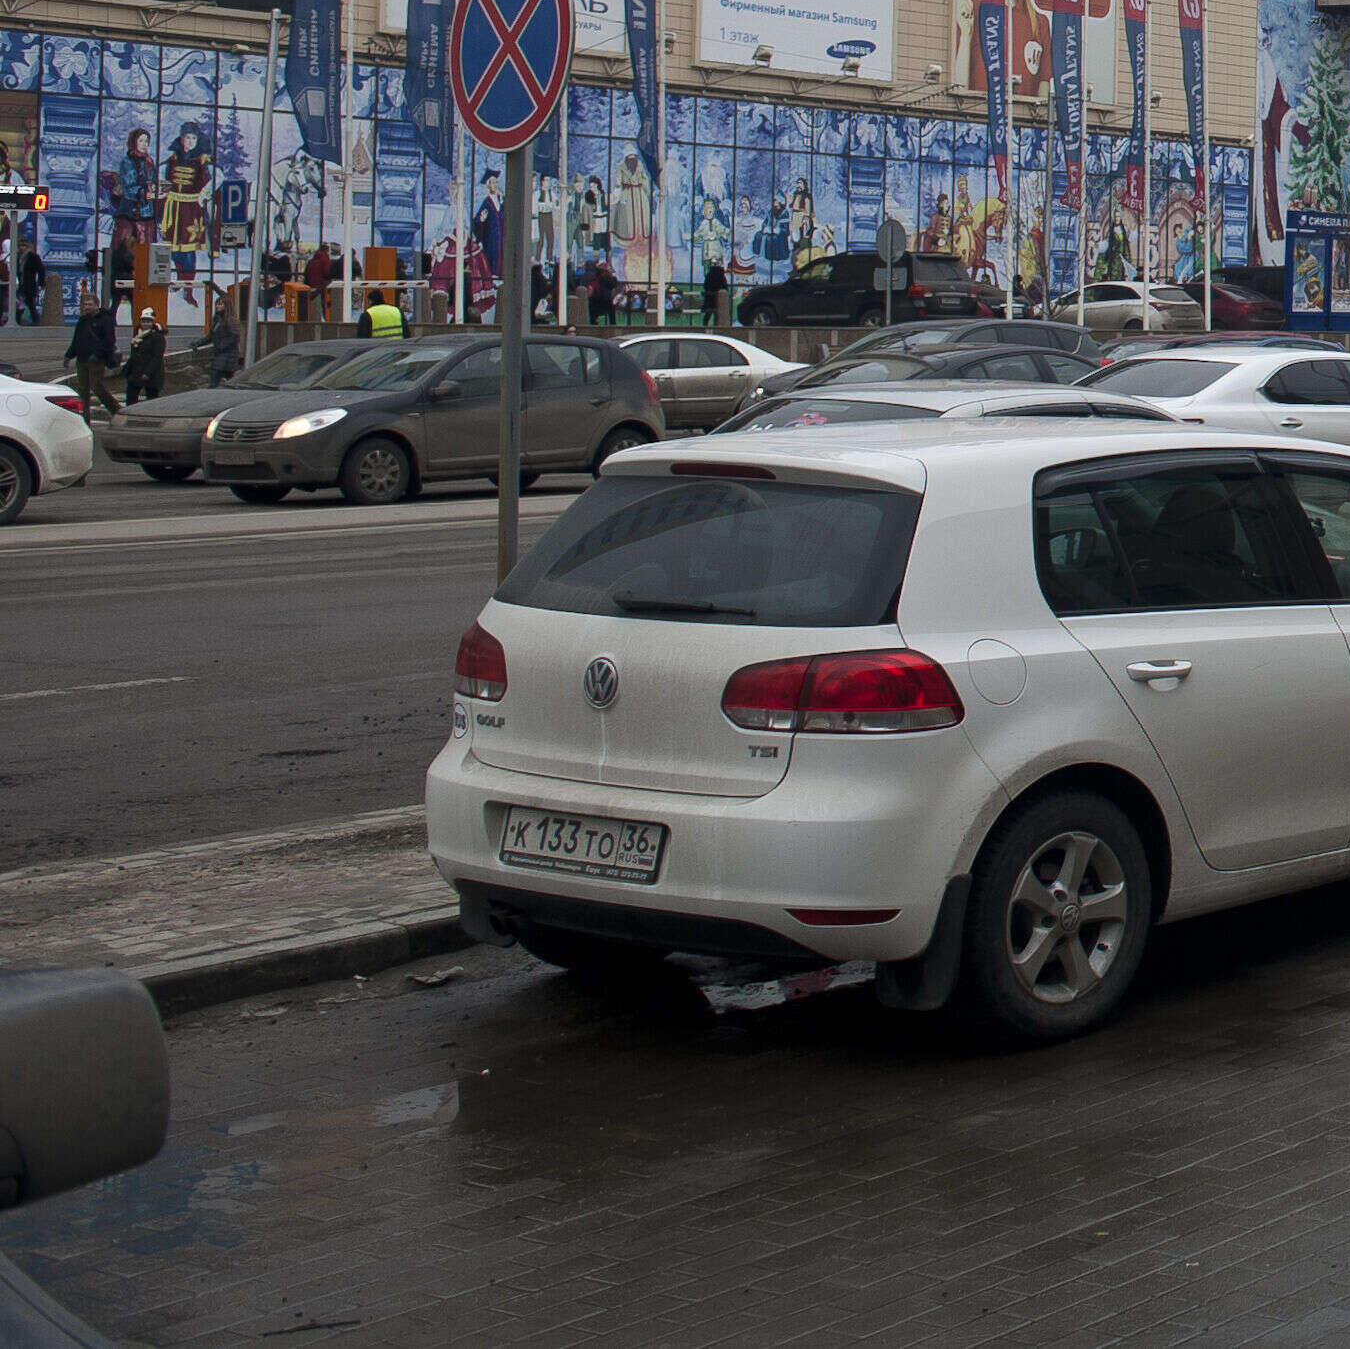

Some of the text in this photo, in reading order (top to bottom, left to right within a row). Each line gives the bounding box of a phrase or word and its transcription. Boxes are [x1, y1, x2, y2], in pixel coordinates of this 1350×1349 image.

[788, 8, 830, 22] магазин
[832, 11, 877, 30] Samsung
[719, 26, 759, 44] 1 этаж
[228, 184, 242, 219] P
[476, 714, 506, 728] GOLF
[748, 745, 778, 757] TSI
[622, 825, 650, 853] 36
[617, 852, 639, 864] RUS
